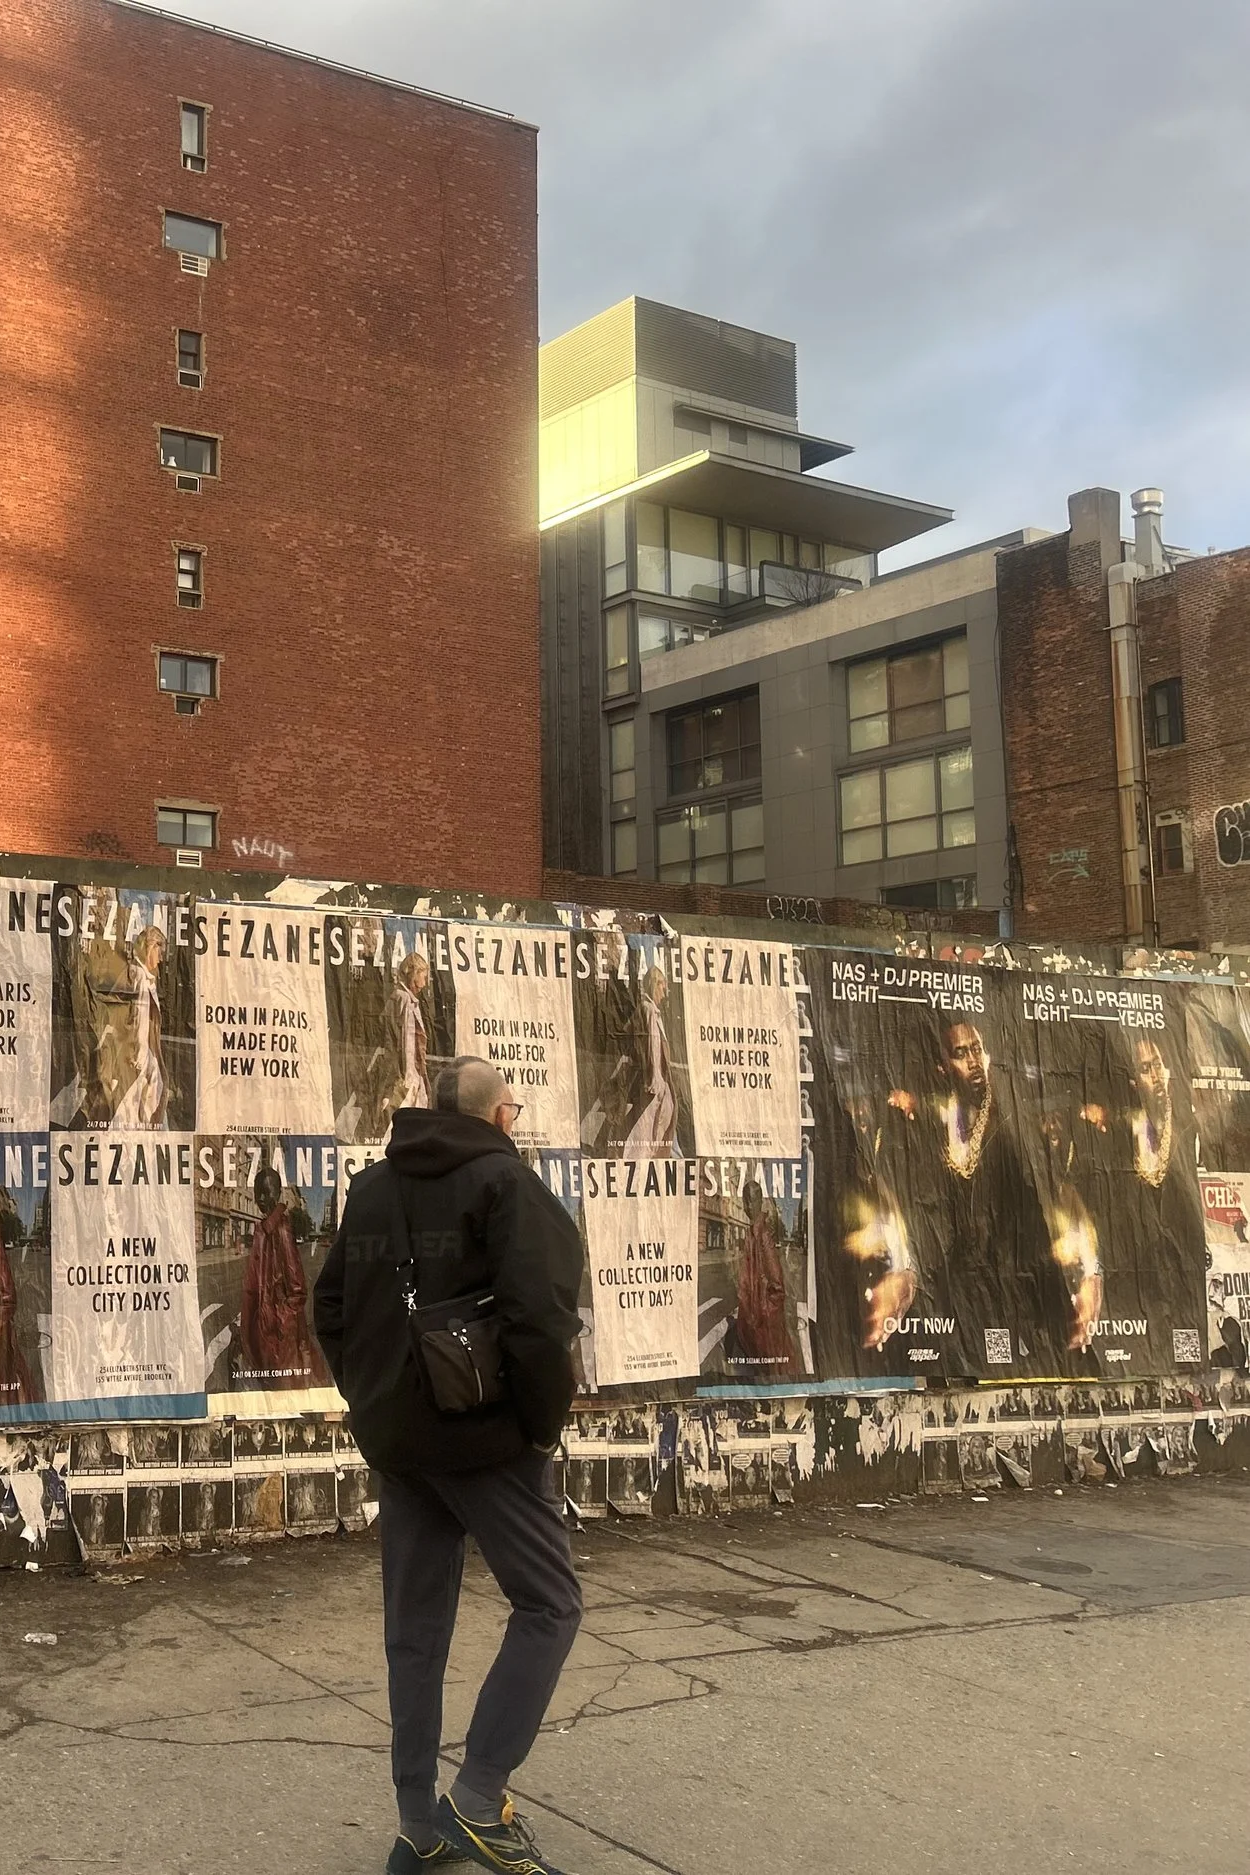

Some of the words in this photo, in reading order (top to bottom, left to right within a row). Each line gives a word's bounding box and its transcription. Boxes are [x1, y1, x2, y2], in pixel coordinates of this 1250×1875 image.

[195, 911, 321, 965] SÉZANE
[330, 921, 449, 971] SÉZANE
[456, 931, 567, 979] SÉZANE
[686, 942, 790, 987] SÉZANE
[832, 961, 866, 982] NAS
[884, 967, 907, 987] DJ
[908, 969, 983, 994] PREMIER
[1022, 983, 1055, 1003] NAS
[1072, 987, 1093, 1006] DJ
[1096, 990, 1164, 1011] PREMIER
[205, 1005, 247, 1025] BORN
[253, 1007, 267, 1026] IN
[272, 1008, 312, 1032] PARIS,
[474, 1017, 505, 1037] BORN
[509, 1020, 519, 1037] IN
[523, 1021, 559, 1042] PARIS,
[222, 1031, 266, 1051] MADE
[270, 1033, 298, 1053] FOR
[700, 1025, 730, 1043] BORN
[733, 1027, 744, 1044] IN
[747, 1027, 782, 1048] PARIS,
[488, 1042, 522, 1061] MADE
[525, 1044, 546, 1063] FOR
[712, 1049, 744, 1066] MADE
[748, 1050, 770, 1067] FOR
[220, 1057, 255, 1076] NEW
[261, 1058, 300, 1079] YORK
[519, 1067, 549, 1087] YORK
[712, 1071, 737, 1088] NEW
[741, 1072, 772, 1090] YORK
[59, 1136, 191, 1186] SÉZANE
[106, 1238, 115, 1257] A
[122, 1237, 156, 1257] NEW
[626, 1243, 634, 1261] A
[639, 1242, 665, 1260] NEW
[67, 1264, 162, 1286] COLLECTION
[167, 1263, 190, 1283] FOR
[598, 1266, 669, 1286] COLLECTION
[670, 1264, 693, 1282] FOR
[92, 1292, 126, 1313] CITY
[133, 1291, 171, 1311] DAYS
[619, 1291, 644, 1309] CITY
[649, 1288, 673, 1307] DAYS
[883, 1317, 921, 1334] OUT
[924, 1317, 955, 1334] NOW
[1086, 1319, 1110, 1336] OUT
[1112, 1319, 1147, 1336] NOW
